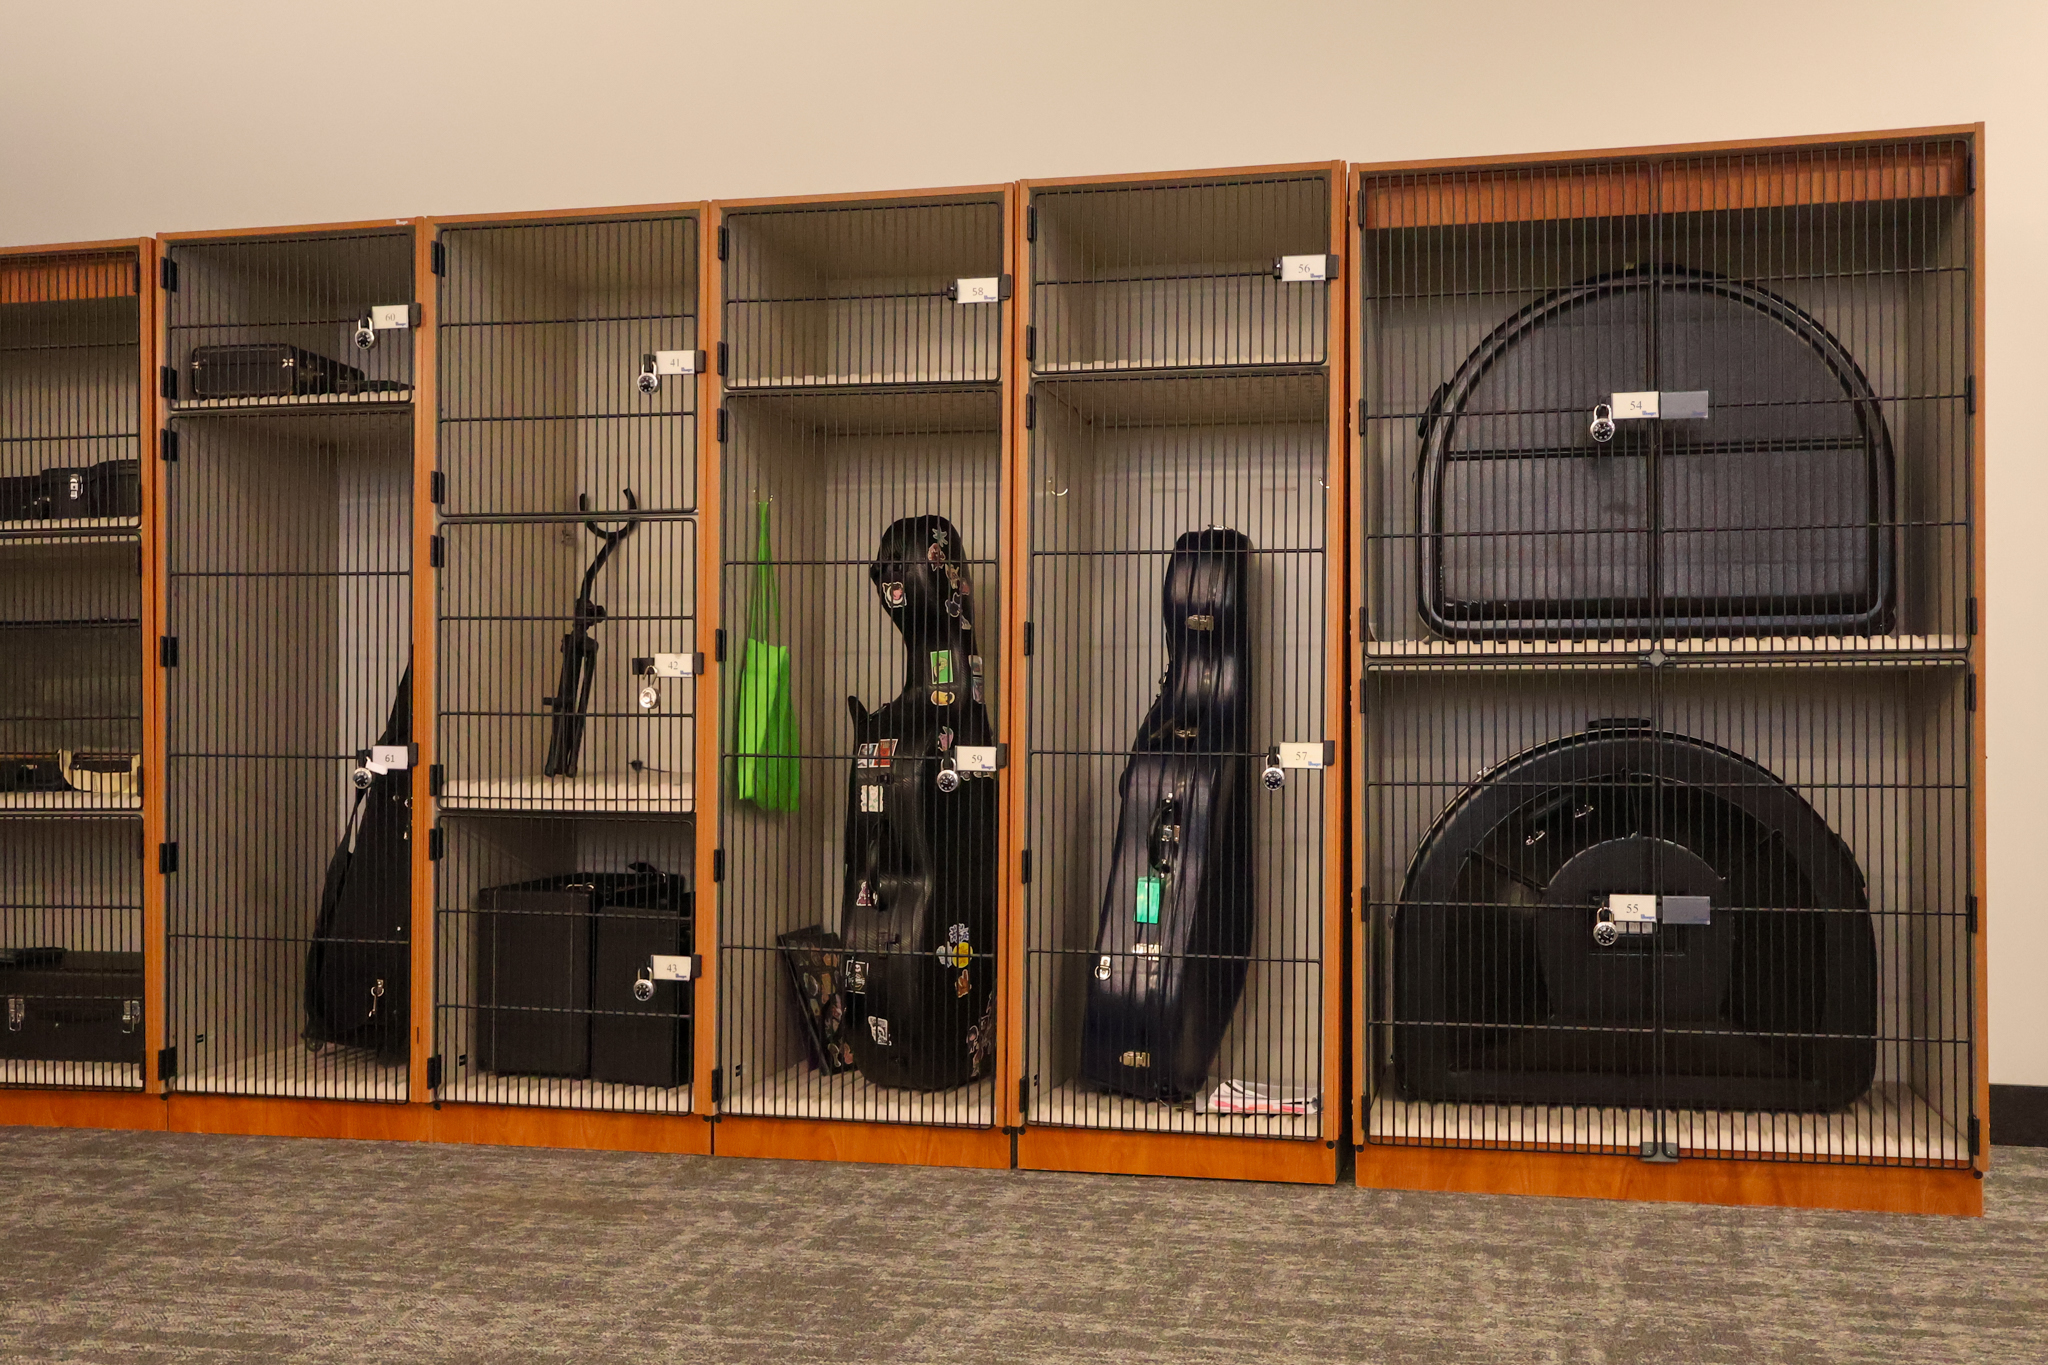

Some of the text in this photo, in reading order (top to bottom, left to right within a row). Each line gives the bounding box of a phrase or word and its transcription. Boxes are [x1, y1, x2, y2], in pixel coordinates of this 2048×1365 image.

[1298, 264, 1311, 273] 56
[972, 287, 984, 296] 58
[385, 313, 396, 322] 60
[670, 358, 680, 367] 41
[1629, 400, 1642, 410] 54
[667, 661, 679, 670] 42
[384, 754, 395, 763] 61
[971, 754, 983, 763] 59
[1295, 751, 1307, 760] 57
[1626, 903, 1639, 913] 55
[666, 963, 678, 972] 43
